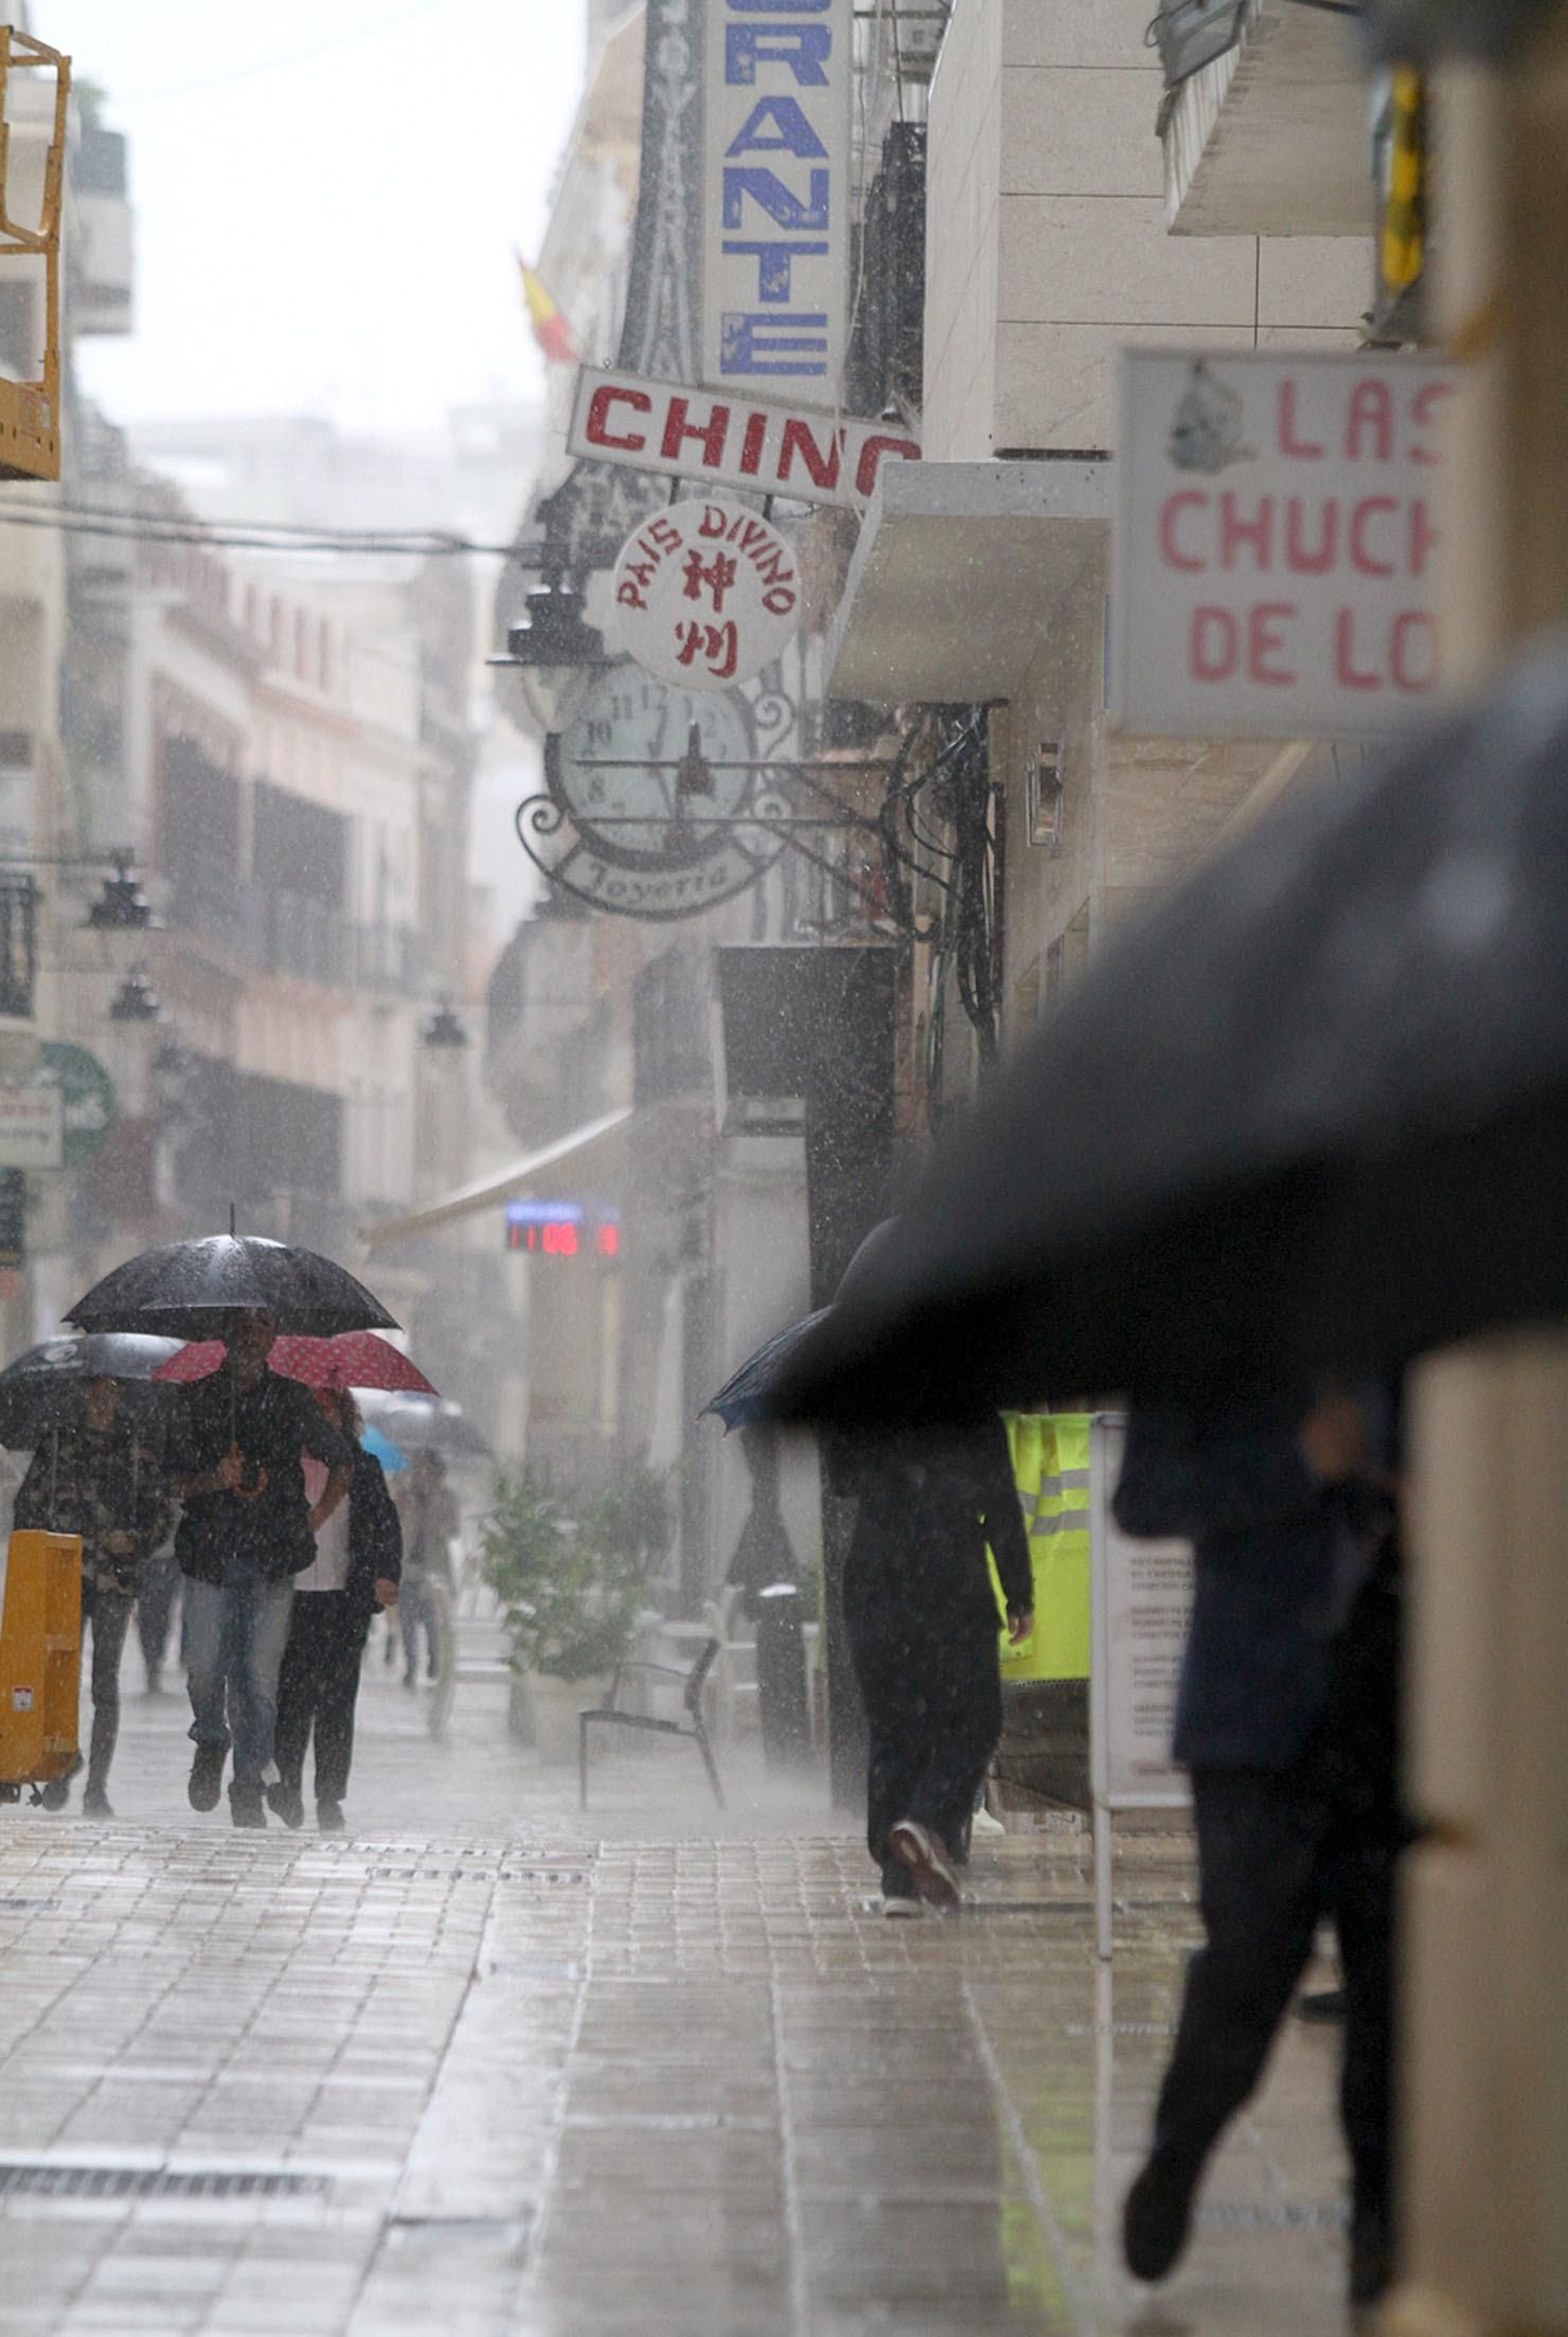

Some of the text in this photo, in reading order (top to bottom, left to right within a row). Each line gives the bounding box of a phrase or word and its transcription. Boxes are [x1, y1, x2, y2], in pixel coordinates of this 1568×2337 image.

[720, 0, 833, 375] RANTE
[616, 505, 797, 616] PAIS DIVINO
[1189, 604, 1298, 684] DE
